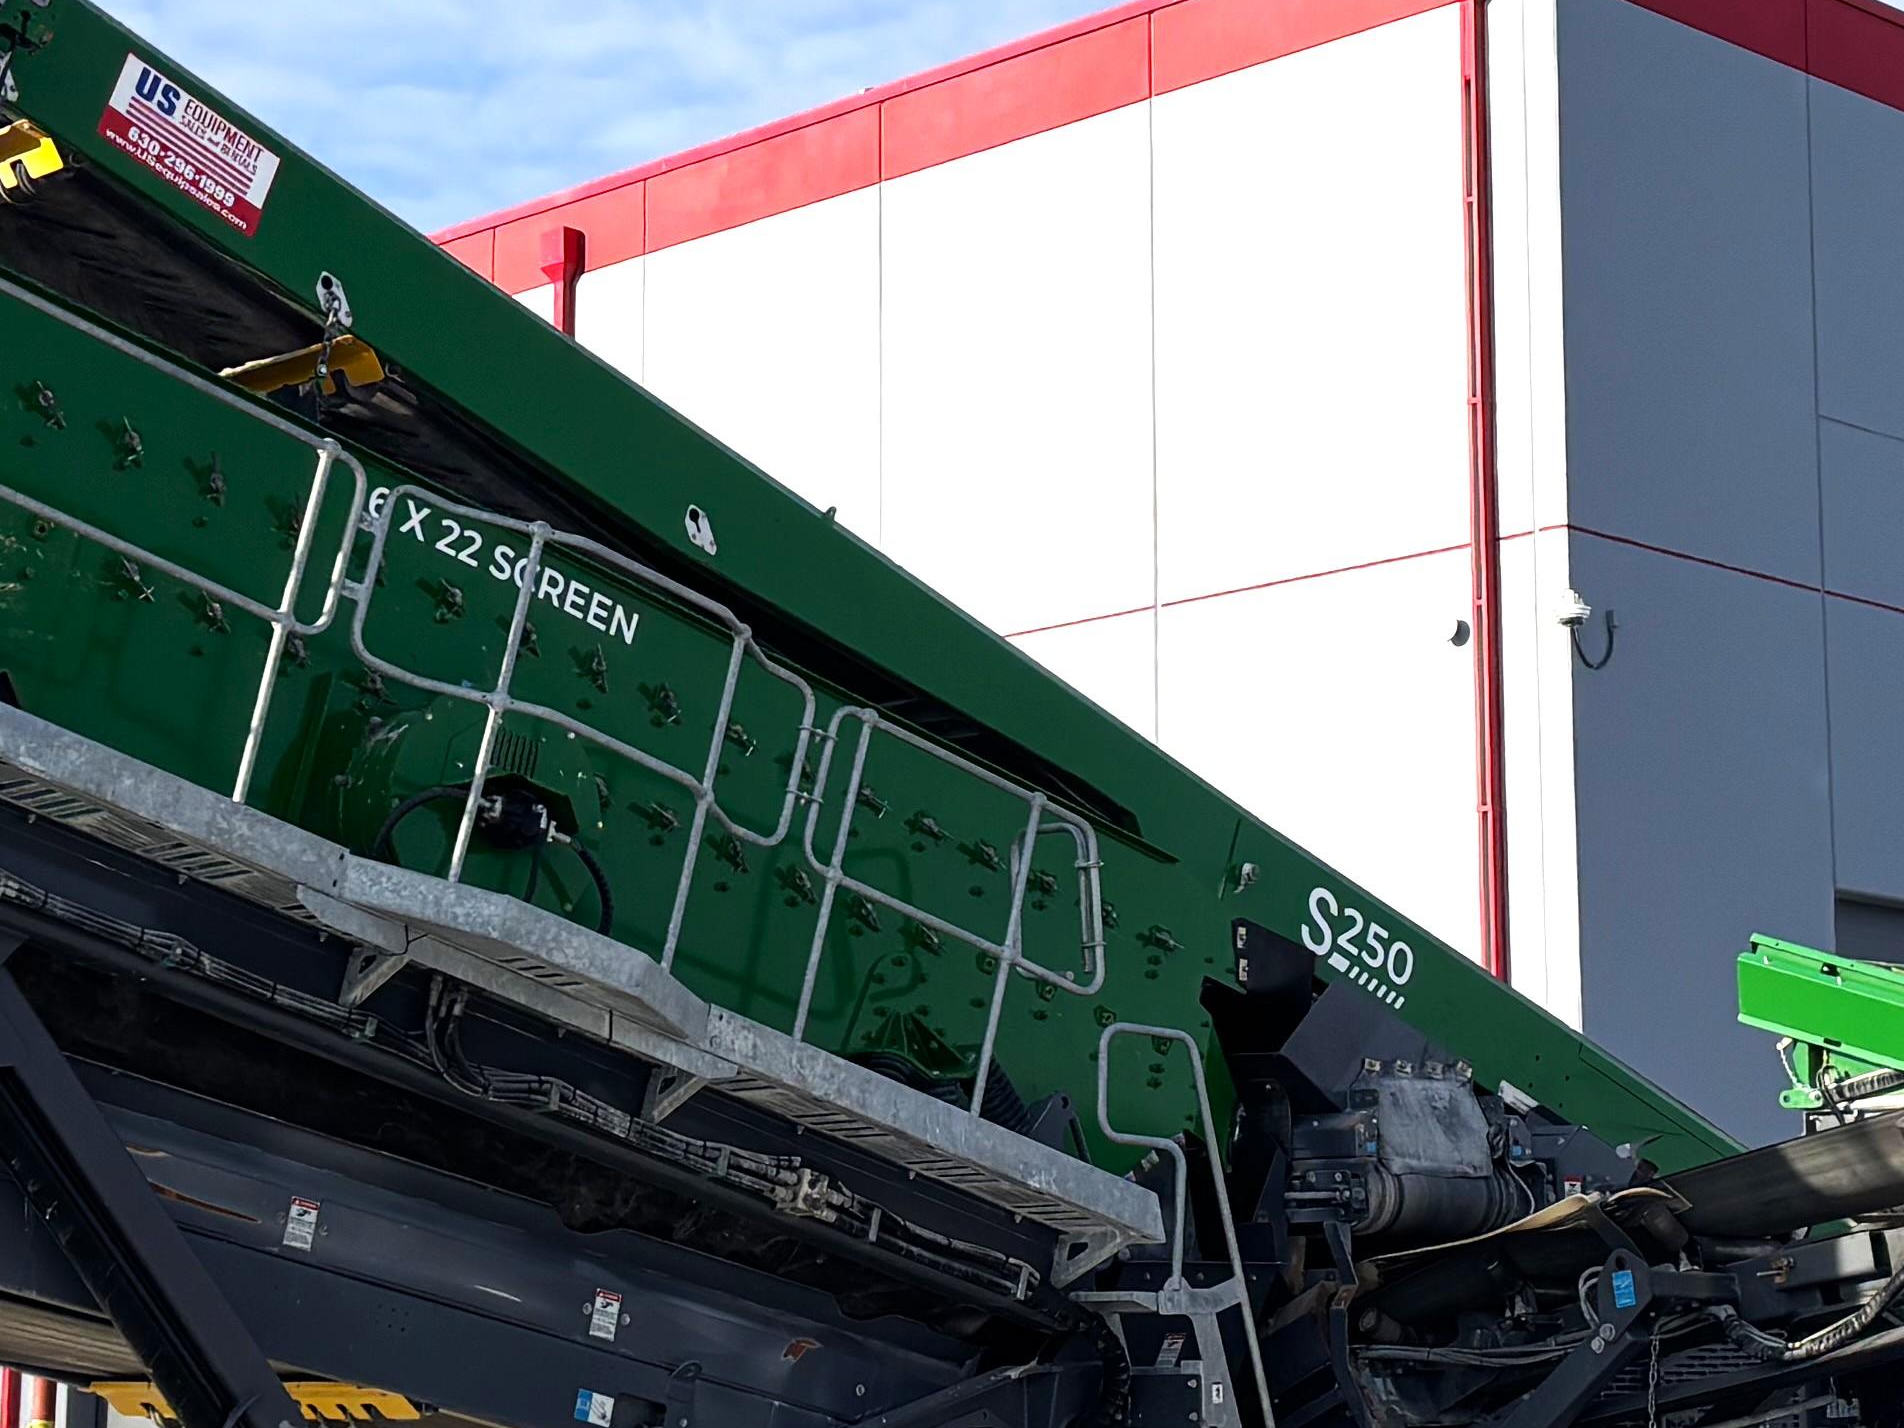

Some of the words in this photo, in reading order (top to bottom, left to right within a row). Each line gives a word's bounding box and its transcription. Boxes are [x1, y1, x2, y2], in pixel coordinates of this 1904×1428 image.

[135, 66, 181, 117] US
[184, 98, 264, 163] EQUIPMENT
[399, 499, 431, 542] X
[434, 519, 483, 568] 22
[488, 544, 640, 645] SCREEN
[1301, 887, 1414, 985] S250
